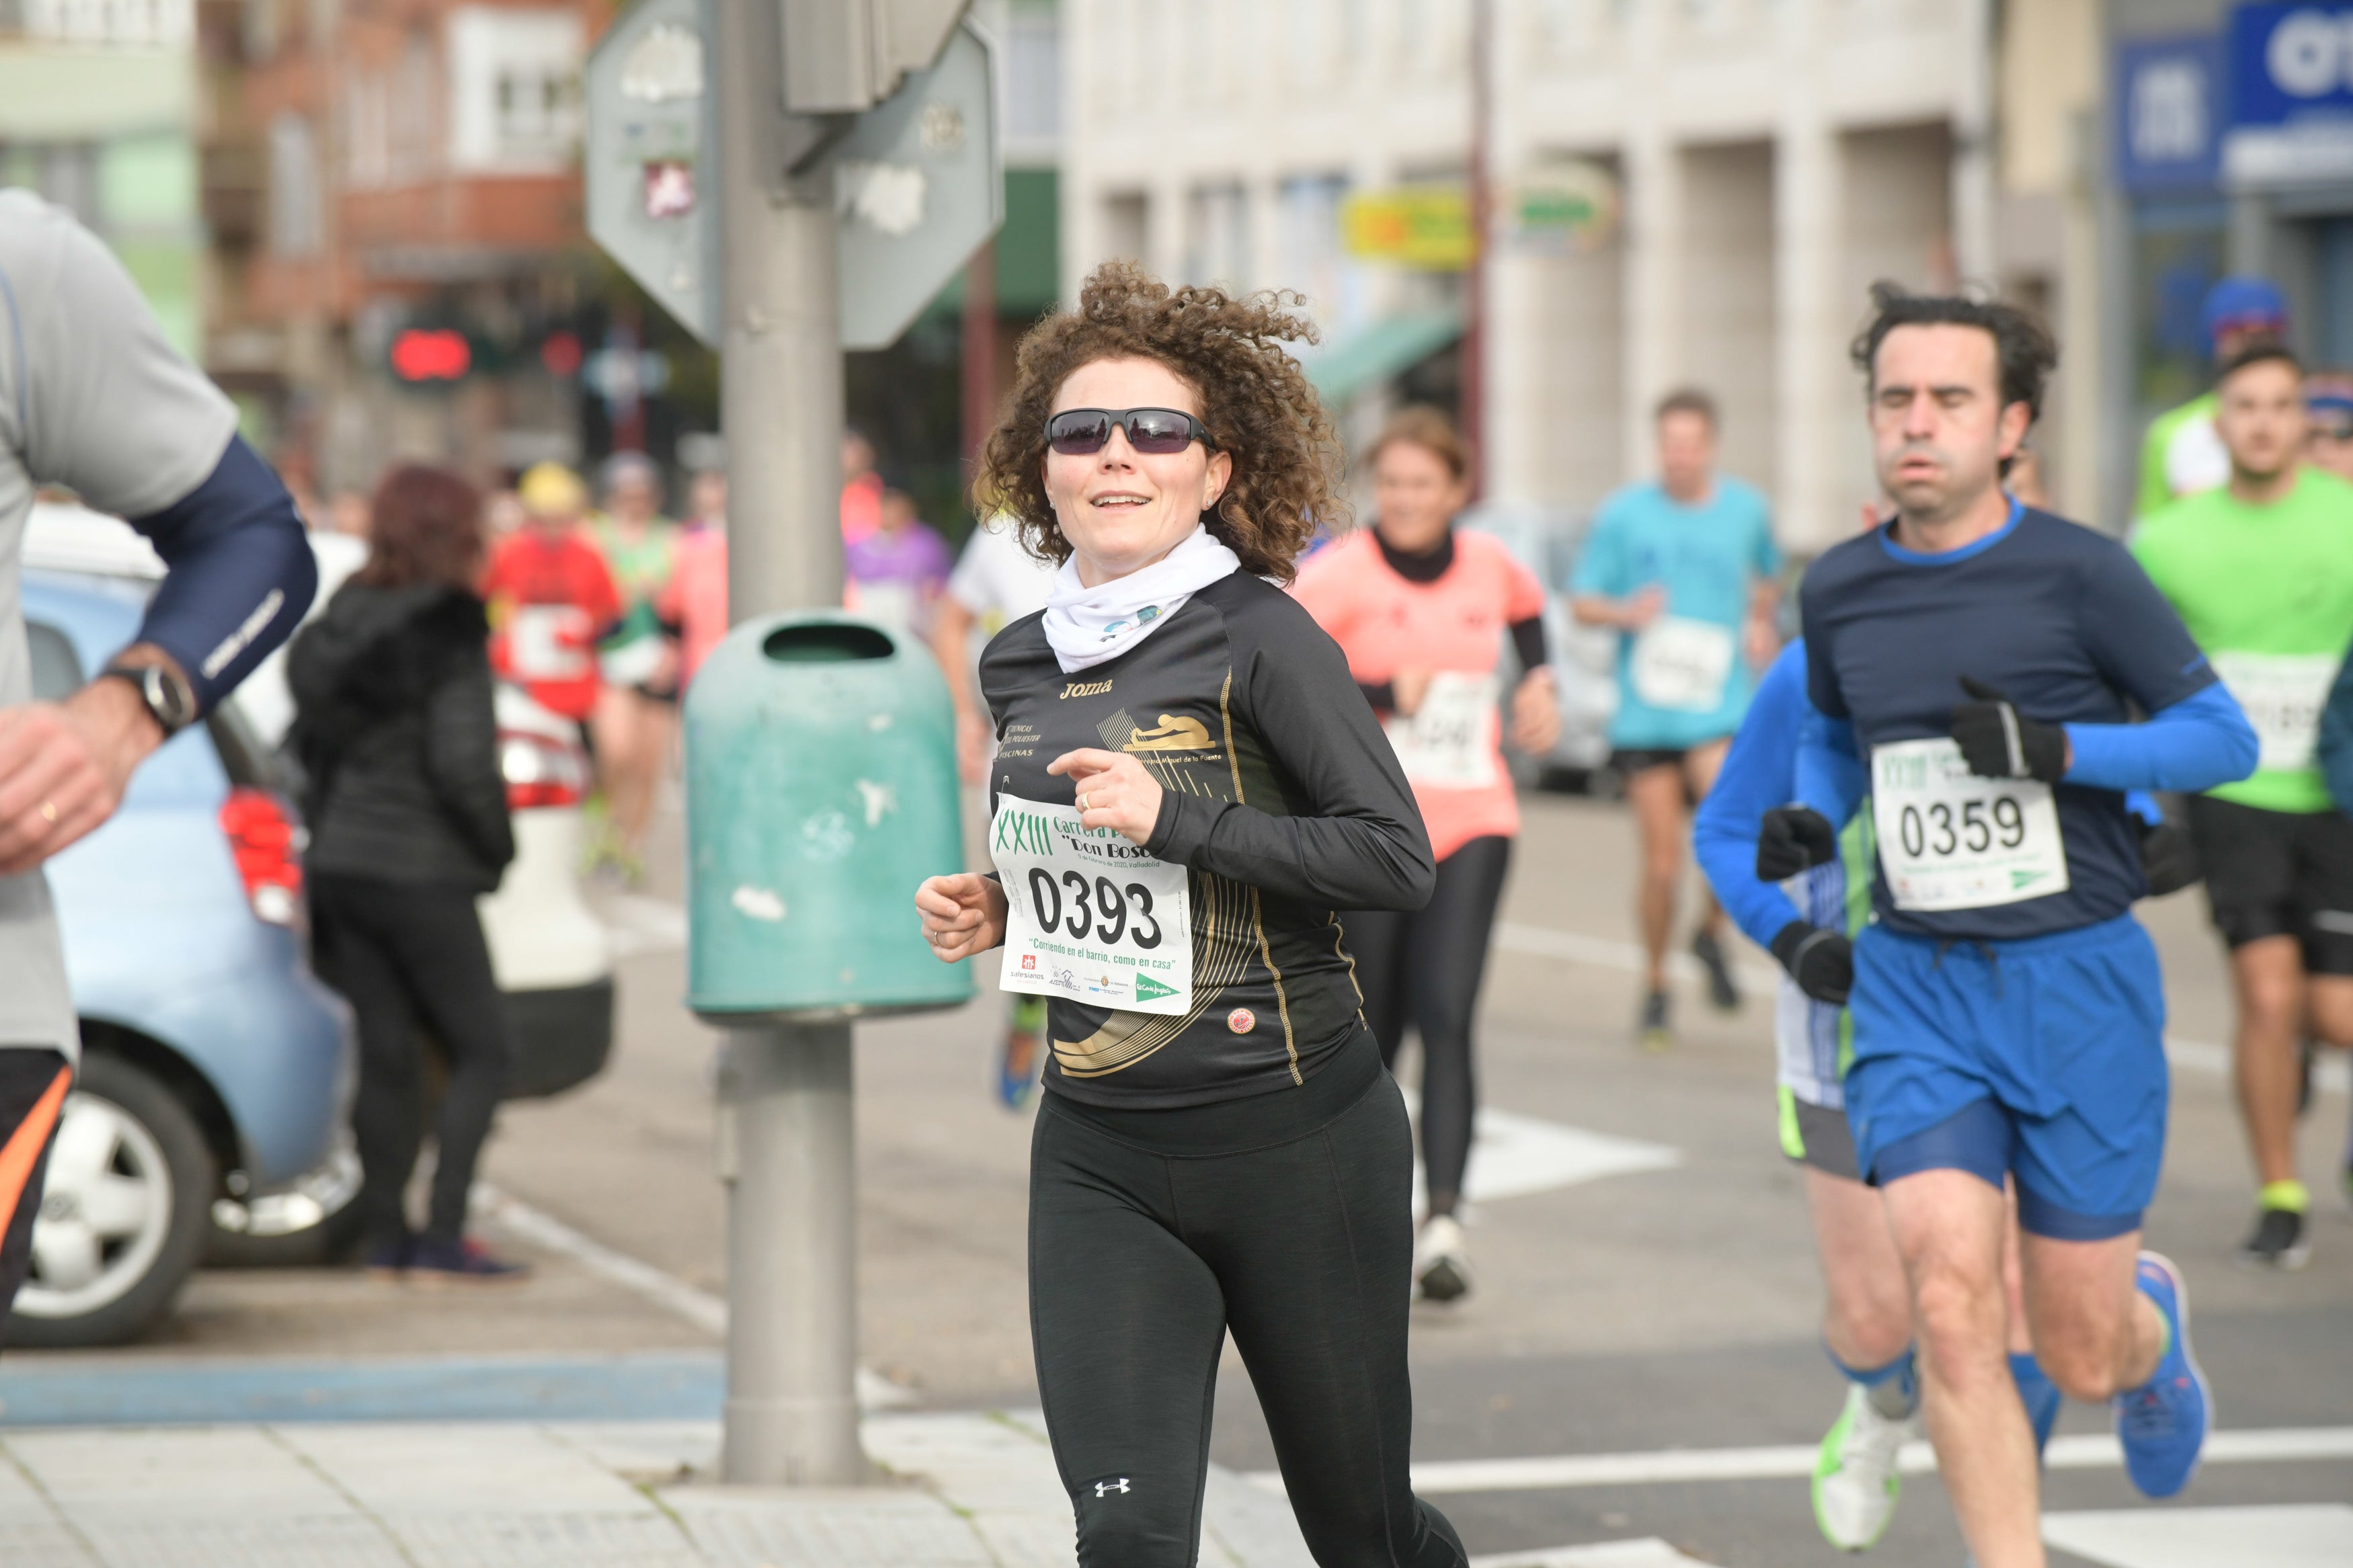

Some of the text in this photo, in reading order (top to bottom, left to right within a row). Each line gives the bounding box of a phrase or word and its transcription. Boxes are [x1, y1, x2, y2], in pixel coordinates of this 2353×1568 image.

[1012, 735, 1041, 743] POLIESTER
[998, 749, 1033, 759] PISCINAS
[996, 808, 1053, 856] XXIII
[1901, 796, 2024, 858] 0359
[1088, 856, 1107, 866] febrero
[1029, 867, 1162, 949] 0393
[1067, 947, 1076, 956] en
[1078, 948, 1084, 958] el
[1086, 948, 1111, 964] barrio,
[1113, 955, 1135, 966] como
[1139, 958, 1150, 967] en
[1010, 971, 1044, 980] salesianos
